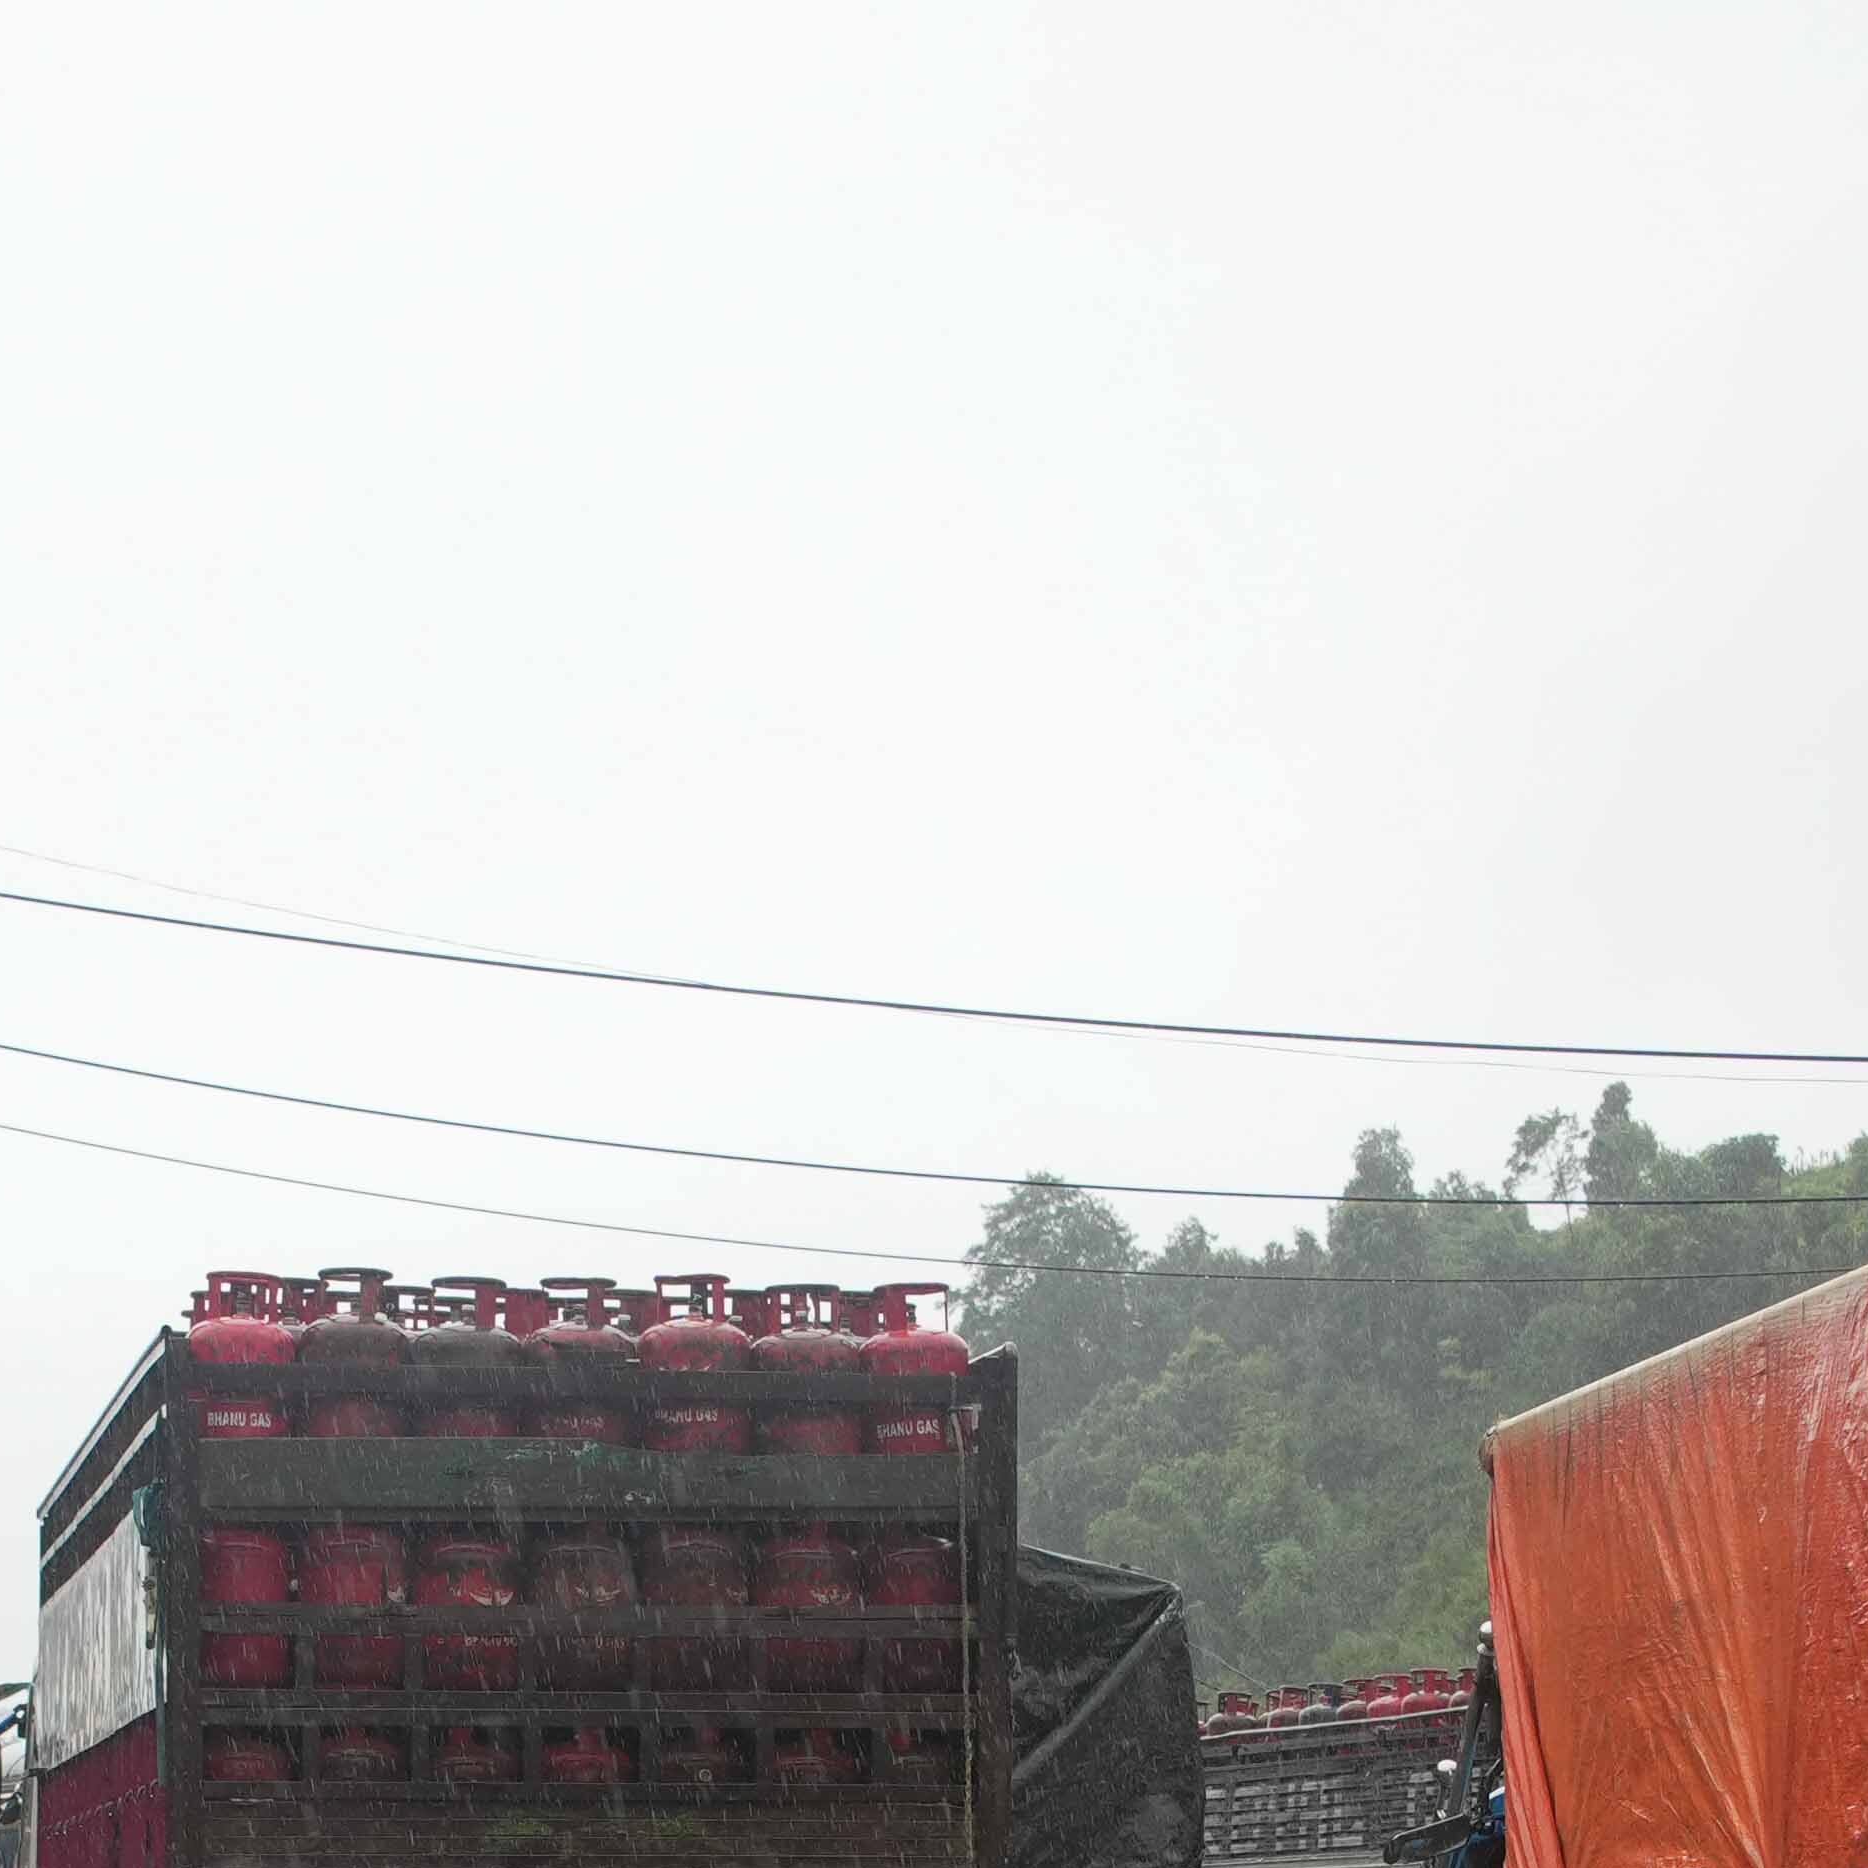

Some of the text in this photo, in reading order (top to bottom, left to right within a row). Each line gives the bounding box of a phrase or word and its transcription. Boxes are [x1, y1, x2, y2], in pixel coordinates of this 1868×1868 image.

[207, 1412, 272, 1428] BHANU GAS
[876, 1418, 941, 1442] BHANU GAS
